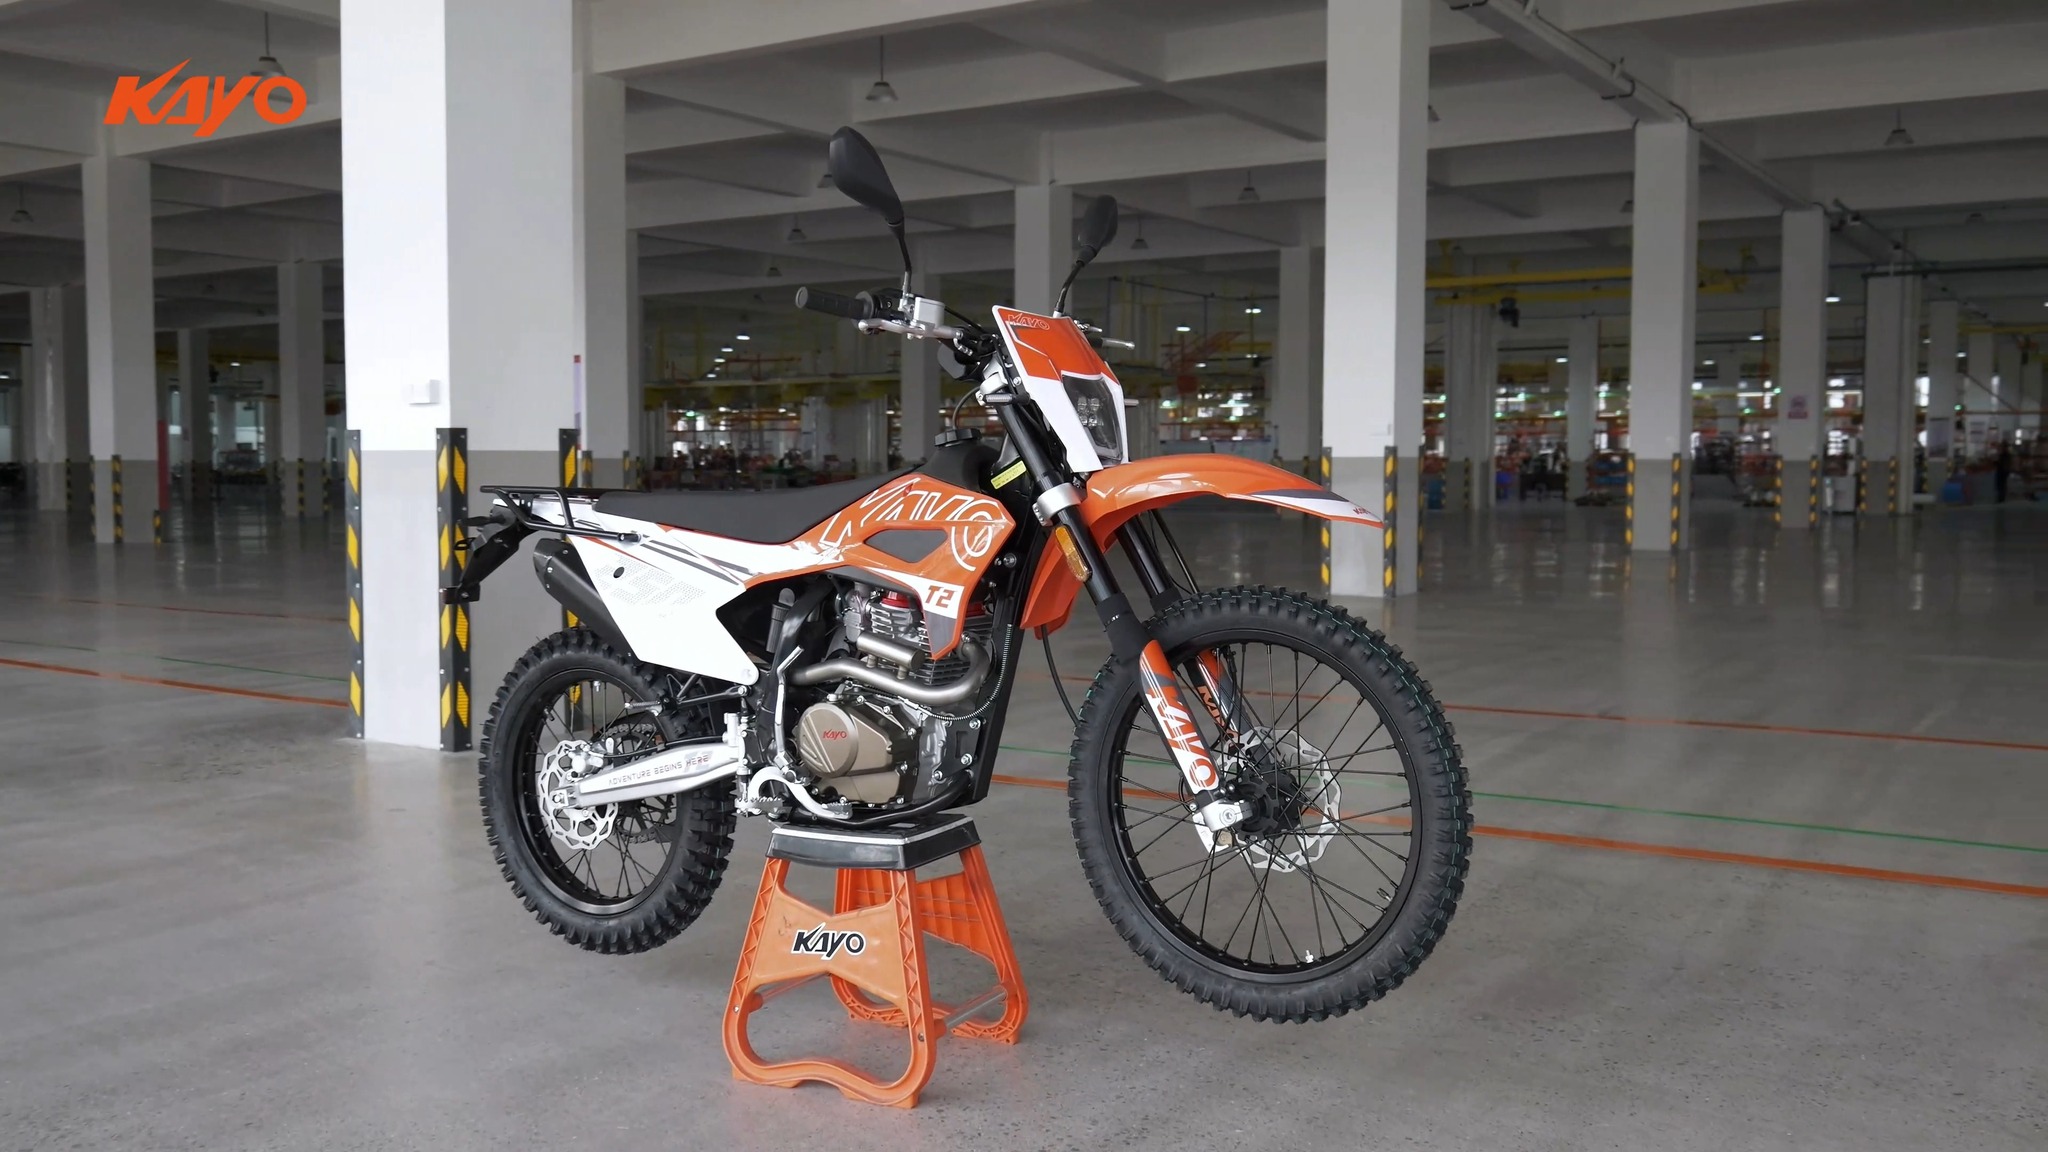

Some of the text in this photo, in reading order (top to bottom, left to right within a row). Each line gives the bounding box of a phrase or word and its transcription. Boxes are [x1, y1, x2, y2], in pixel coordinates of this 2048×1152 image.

[1007, 313, 1050, 330] KAYO
[925, 585, 956, 608] T2
[822, 729, 847, 740] KAYO
[608, 769, 651, 786] ADVENTURE
[654, 761, 683, 775] BEGINS
[685, 754, 709, 768] HERE
[792, 924, 865, 959] KAYO
